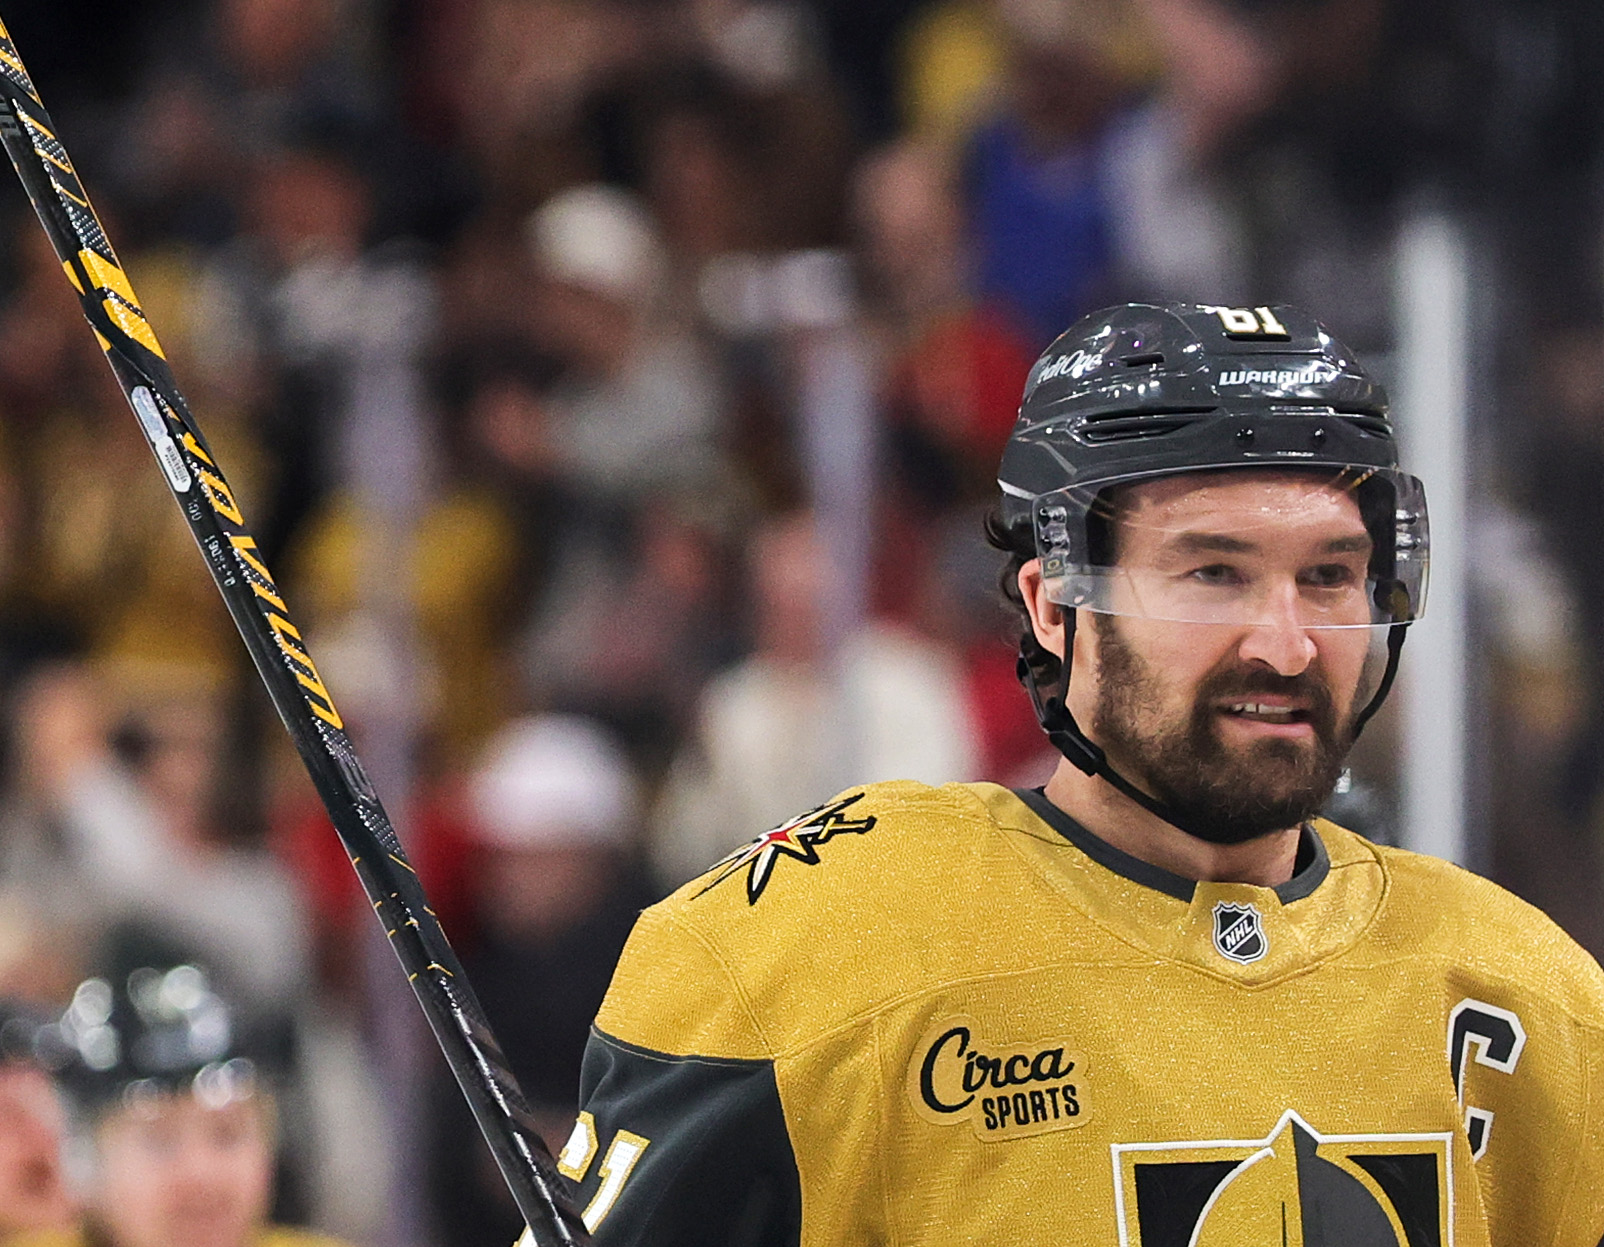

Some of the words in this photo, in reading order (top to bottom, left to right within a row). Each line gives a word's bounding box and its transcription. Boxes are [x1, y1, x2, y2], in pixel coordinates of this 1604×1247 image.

[1224, 918, 1254, 950] NHL
[920, 1026, 1076, 1114] Circa
[1446, 997, 1528, 1163] C
[982, 1083, 1081, 1131] SPORTS
